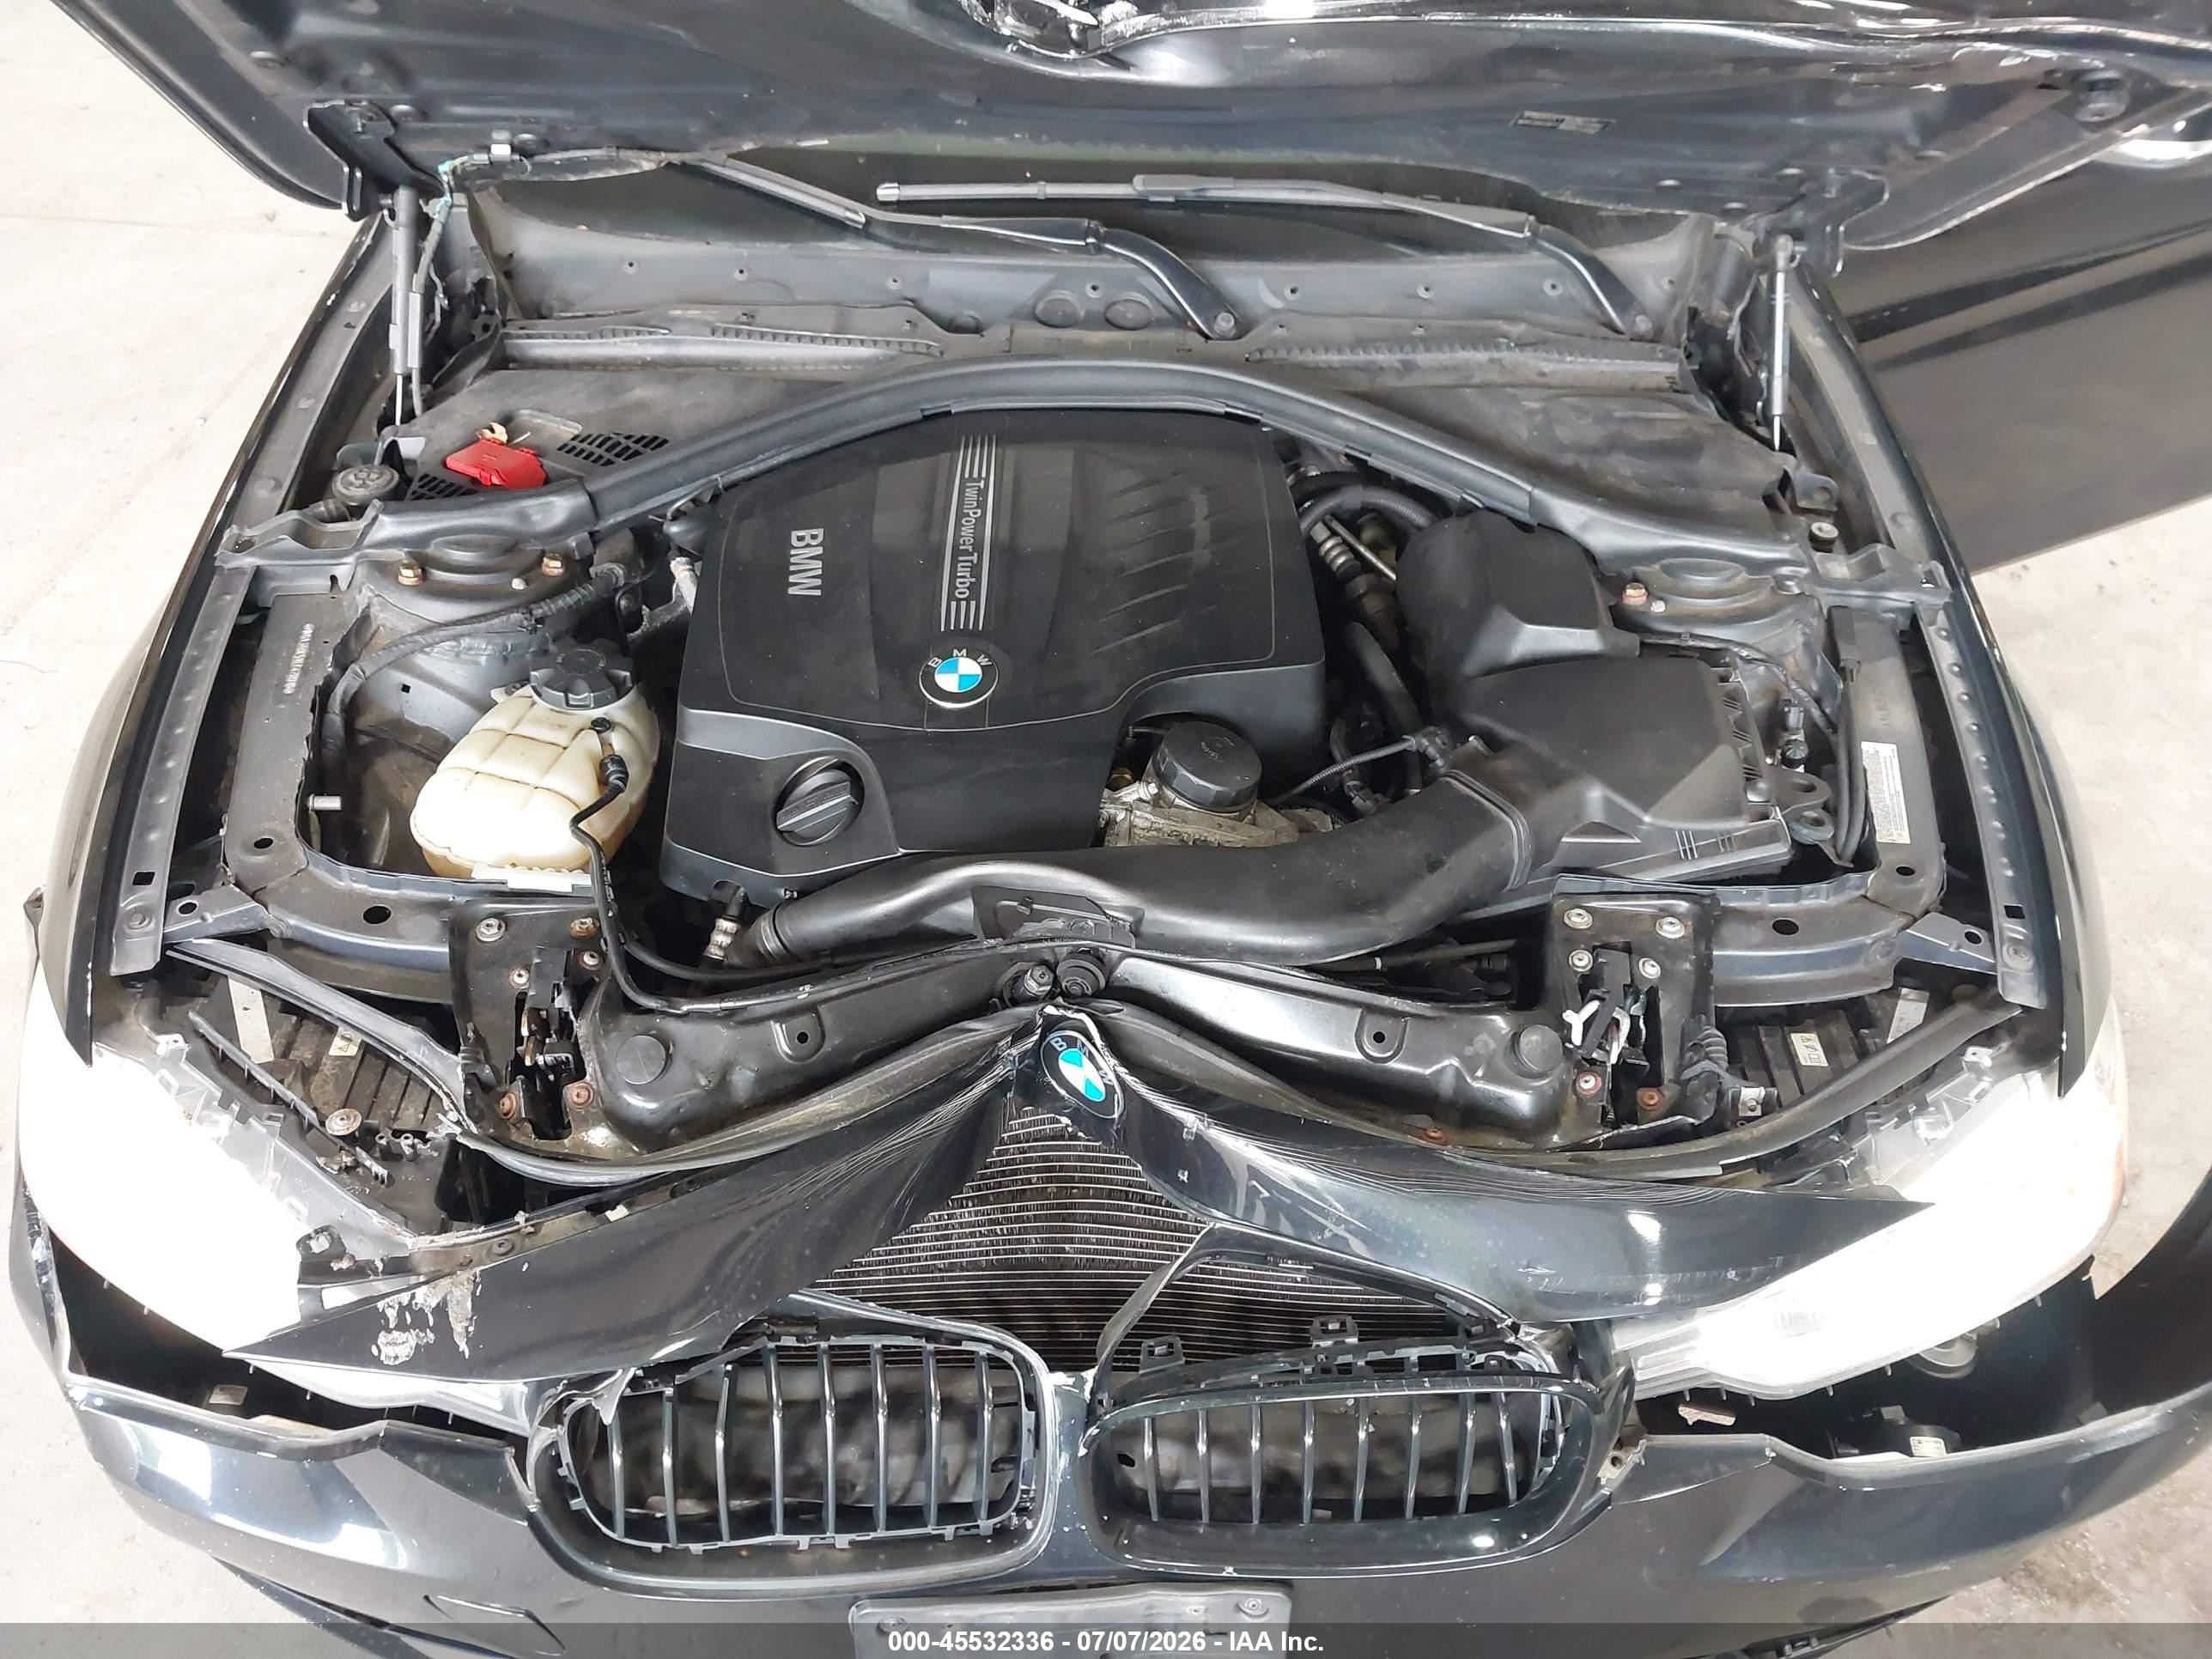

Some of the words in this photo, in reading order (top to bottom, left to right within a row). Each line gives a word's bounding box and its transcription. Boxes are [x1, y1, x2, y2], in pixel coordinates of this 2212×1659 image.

[959, 479, 985, 552] TwinPower
[787, 527, 824, 596] BMW
[954, 552, 978, 599] Turbo
[927, 648, 993, 668] BMW
[1049, 1036, 1115, 1086] BMW
